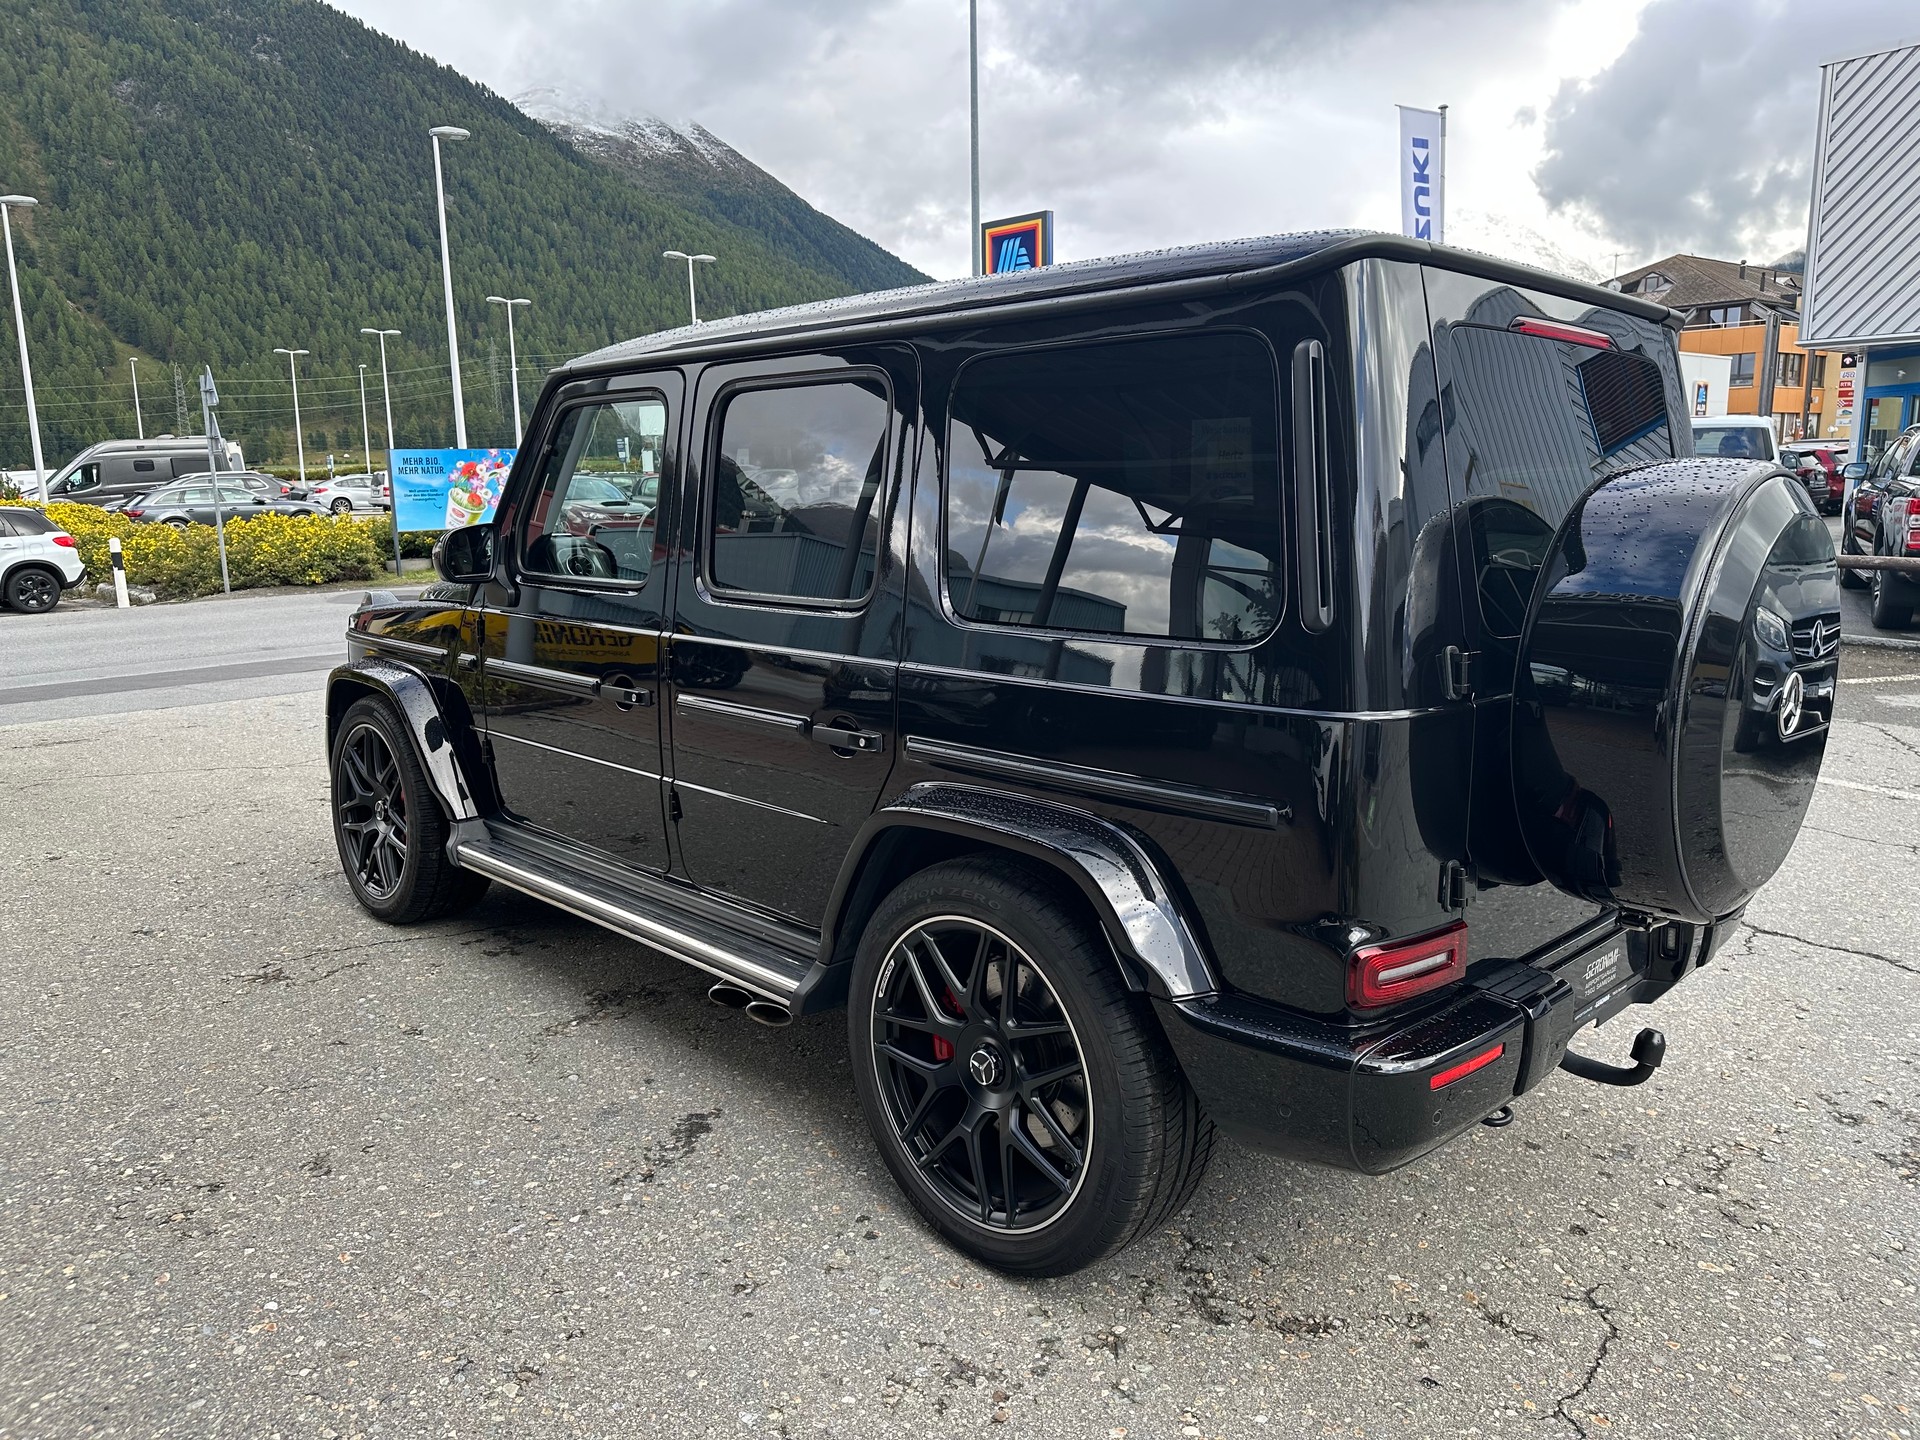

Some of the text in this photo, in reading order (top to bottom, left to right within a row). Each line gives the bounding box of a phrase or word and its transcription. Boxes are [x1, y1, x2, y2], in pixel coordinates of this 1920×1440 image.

[402, 457, 441, 465] MEHR BIO.
[421, 466, 447, 474] NATUR.
